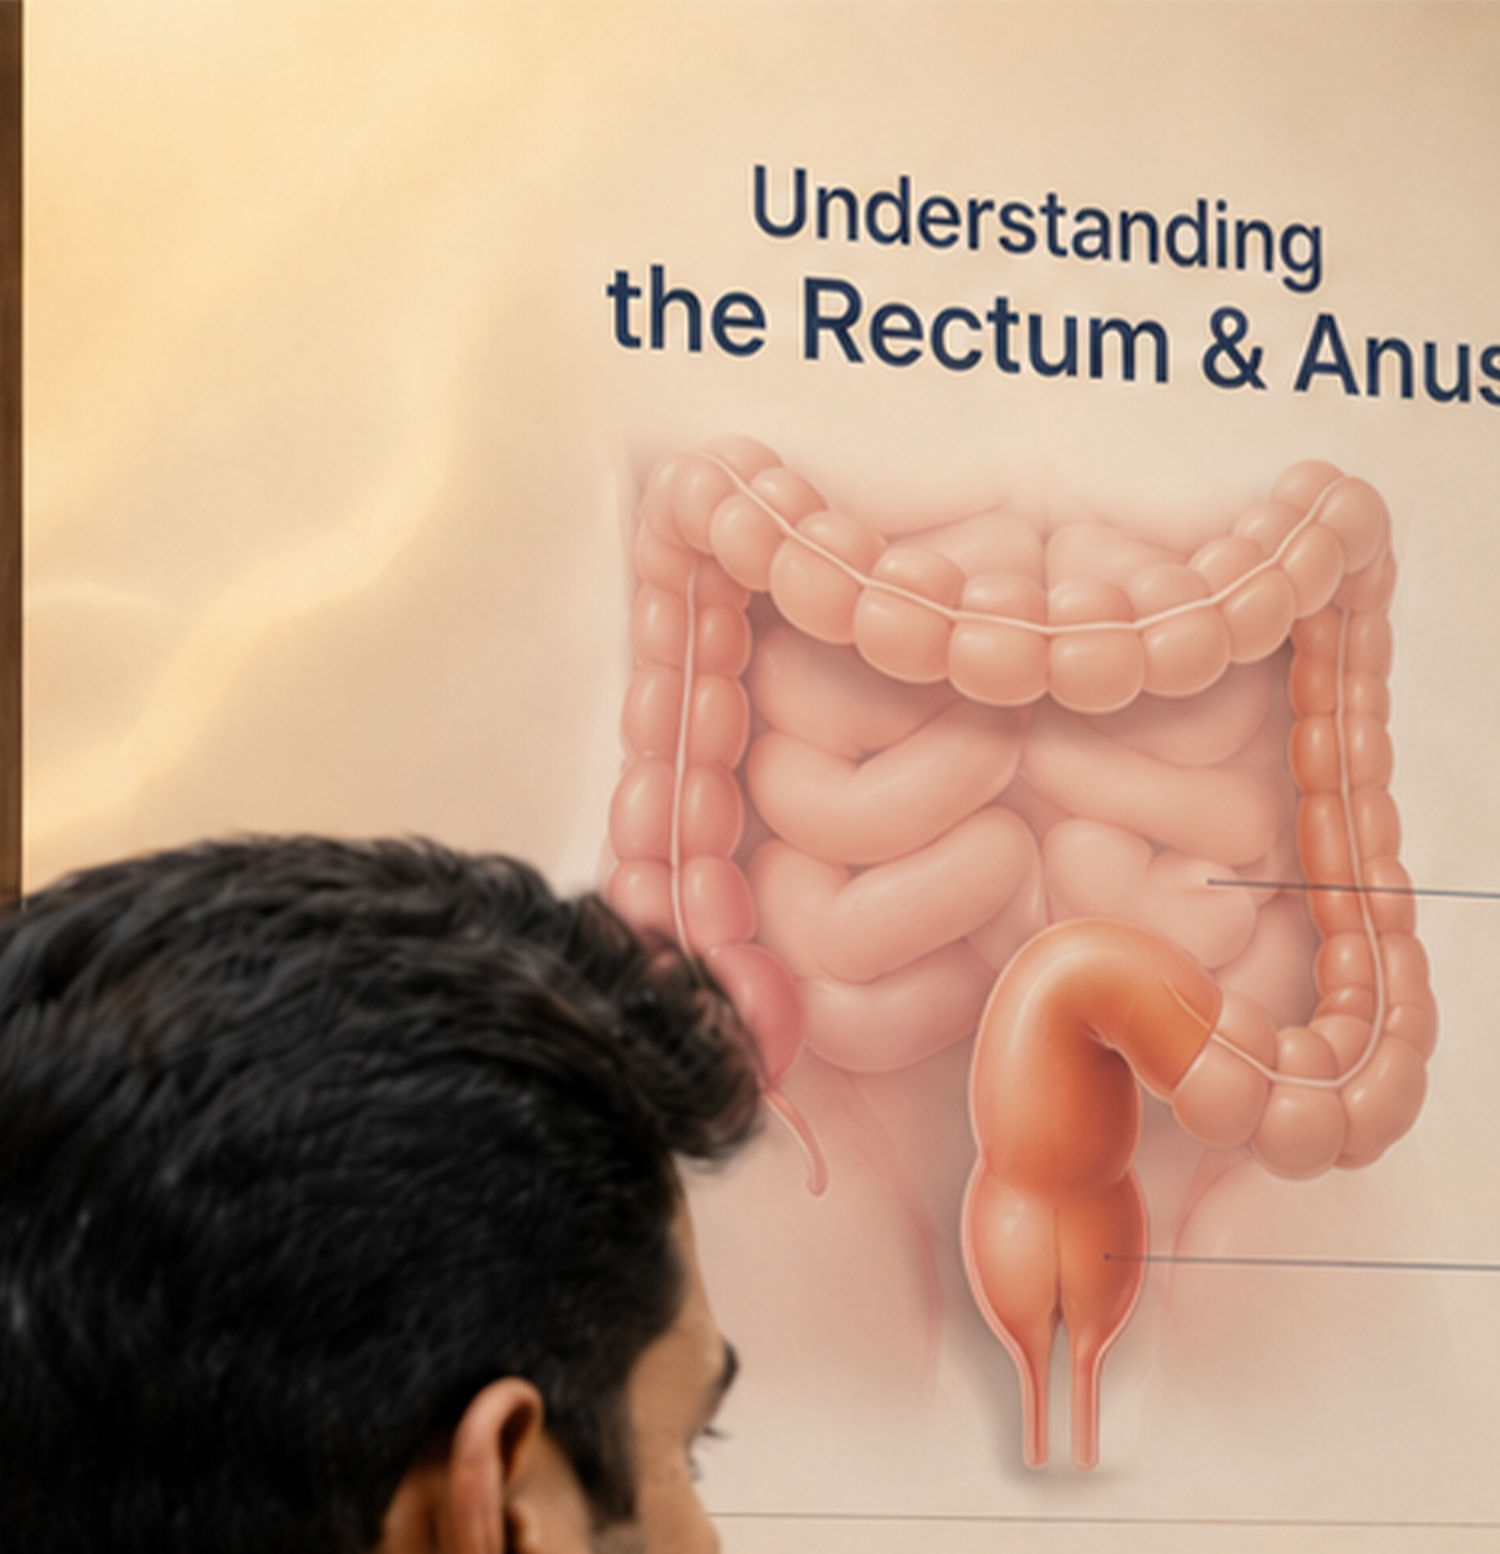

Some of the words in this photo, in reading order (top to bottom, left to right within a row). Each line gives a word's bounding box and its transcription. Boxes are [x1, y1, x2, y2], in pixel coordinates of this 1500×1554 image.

[754, 165, 1323, 294] Understanding
[606, 264, 767, 357] the
[803, 277, 1171, 384] Rectum
[1202, 306, 1268, 391] &
